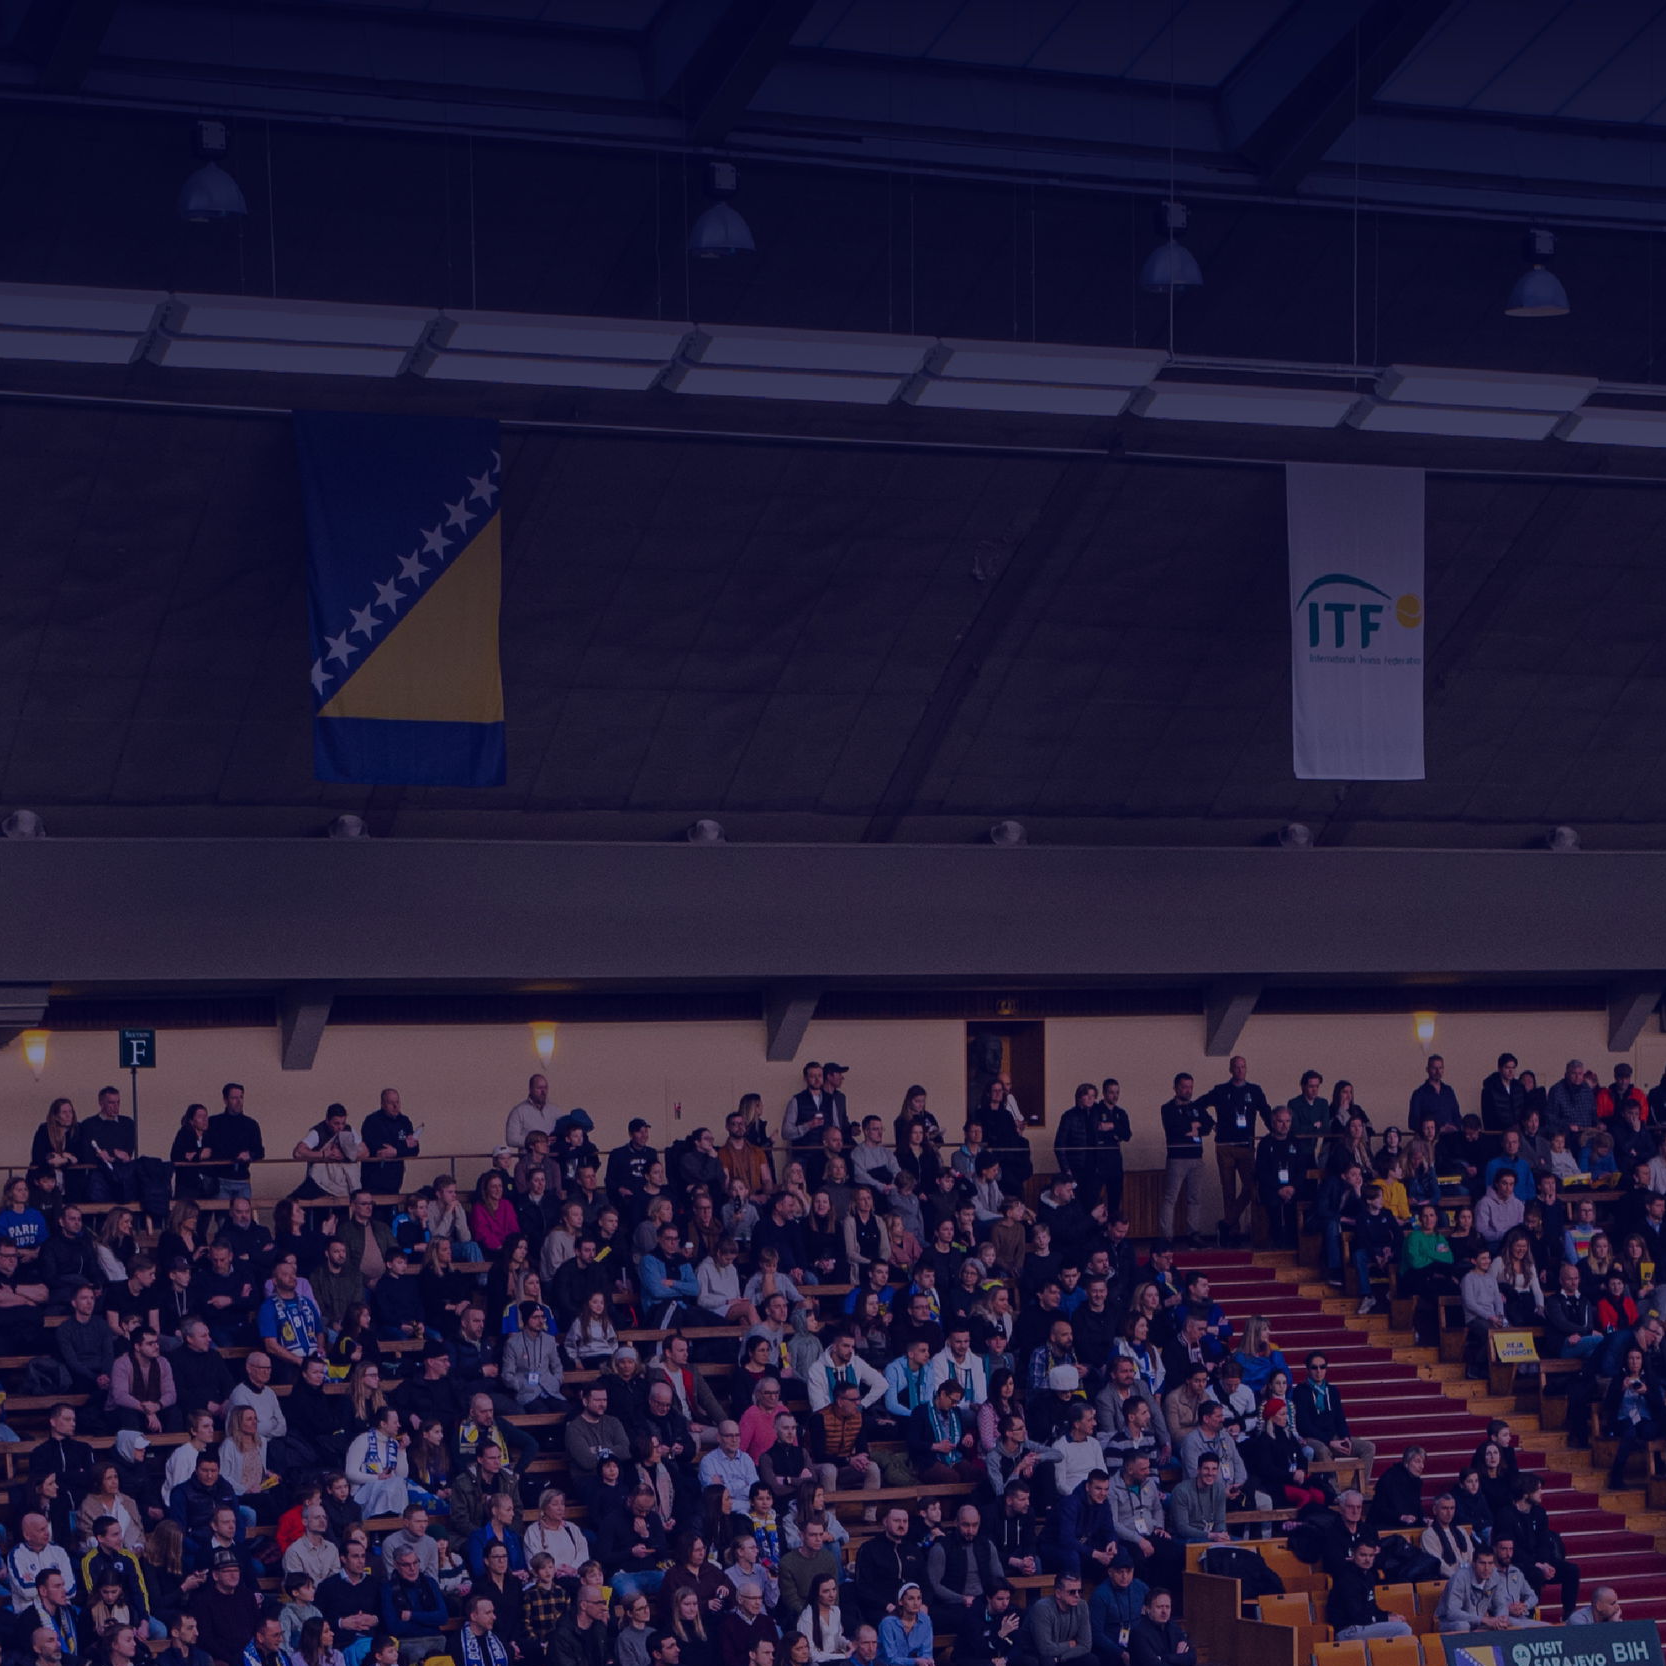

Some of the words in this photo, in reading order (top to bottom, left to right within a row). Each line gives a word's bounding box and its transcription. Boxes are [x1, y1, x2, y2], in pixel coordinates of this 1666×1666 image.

[1309, 603, 1383, 648] ITF
[129, 1040, 146, 1065] F
[1530, 1640, 1564, 1655] VISIT
[1612, 1640, 1650, 1663] BIH
